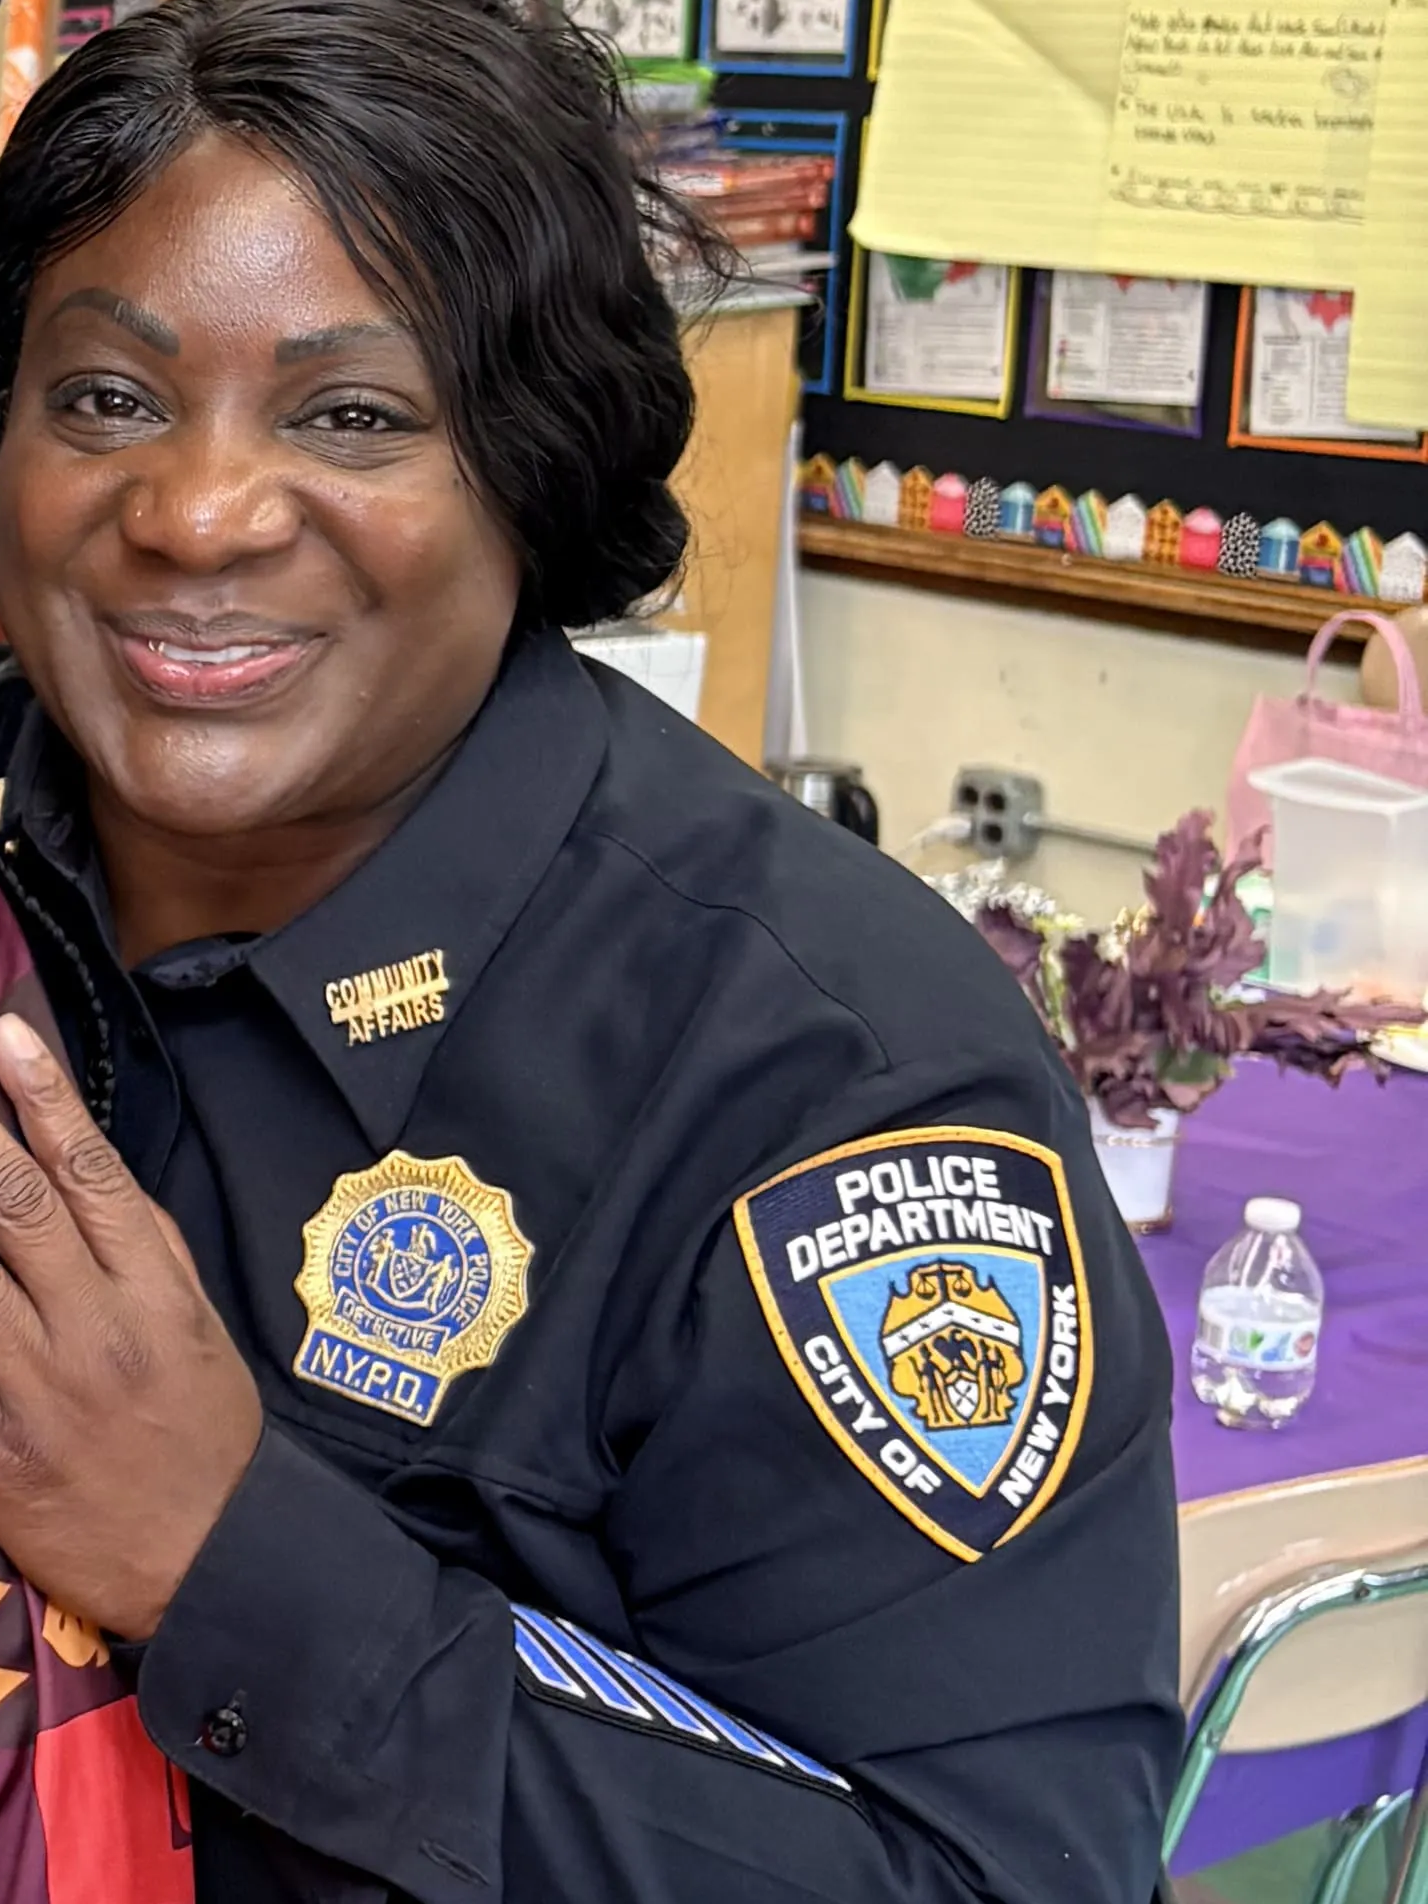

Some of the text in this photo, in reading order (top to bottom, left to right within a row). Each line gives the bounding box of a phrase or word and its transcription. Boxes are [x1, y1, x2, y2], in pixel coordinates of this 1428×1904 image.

[325, 948, 447, 1011] COMMUNITY
[347, 991, 447, 1047] AFFAIRS
[835, 1154, 1002, 1215] POLICE
[332, 1190, 491, 1330] CITY OF NEW YORK POLICE
[785, 1198, 1056, 1282] DEPARTMENT
[341, 1299, 437, 1352] DETECTIVE
[308, 1338, 425, 1414] N.Y.P.D.
[998, 1284, 1079, 1508] NEW YORK
[804, 1335, 942, 1497] CITY OF
